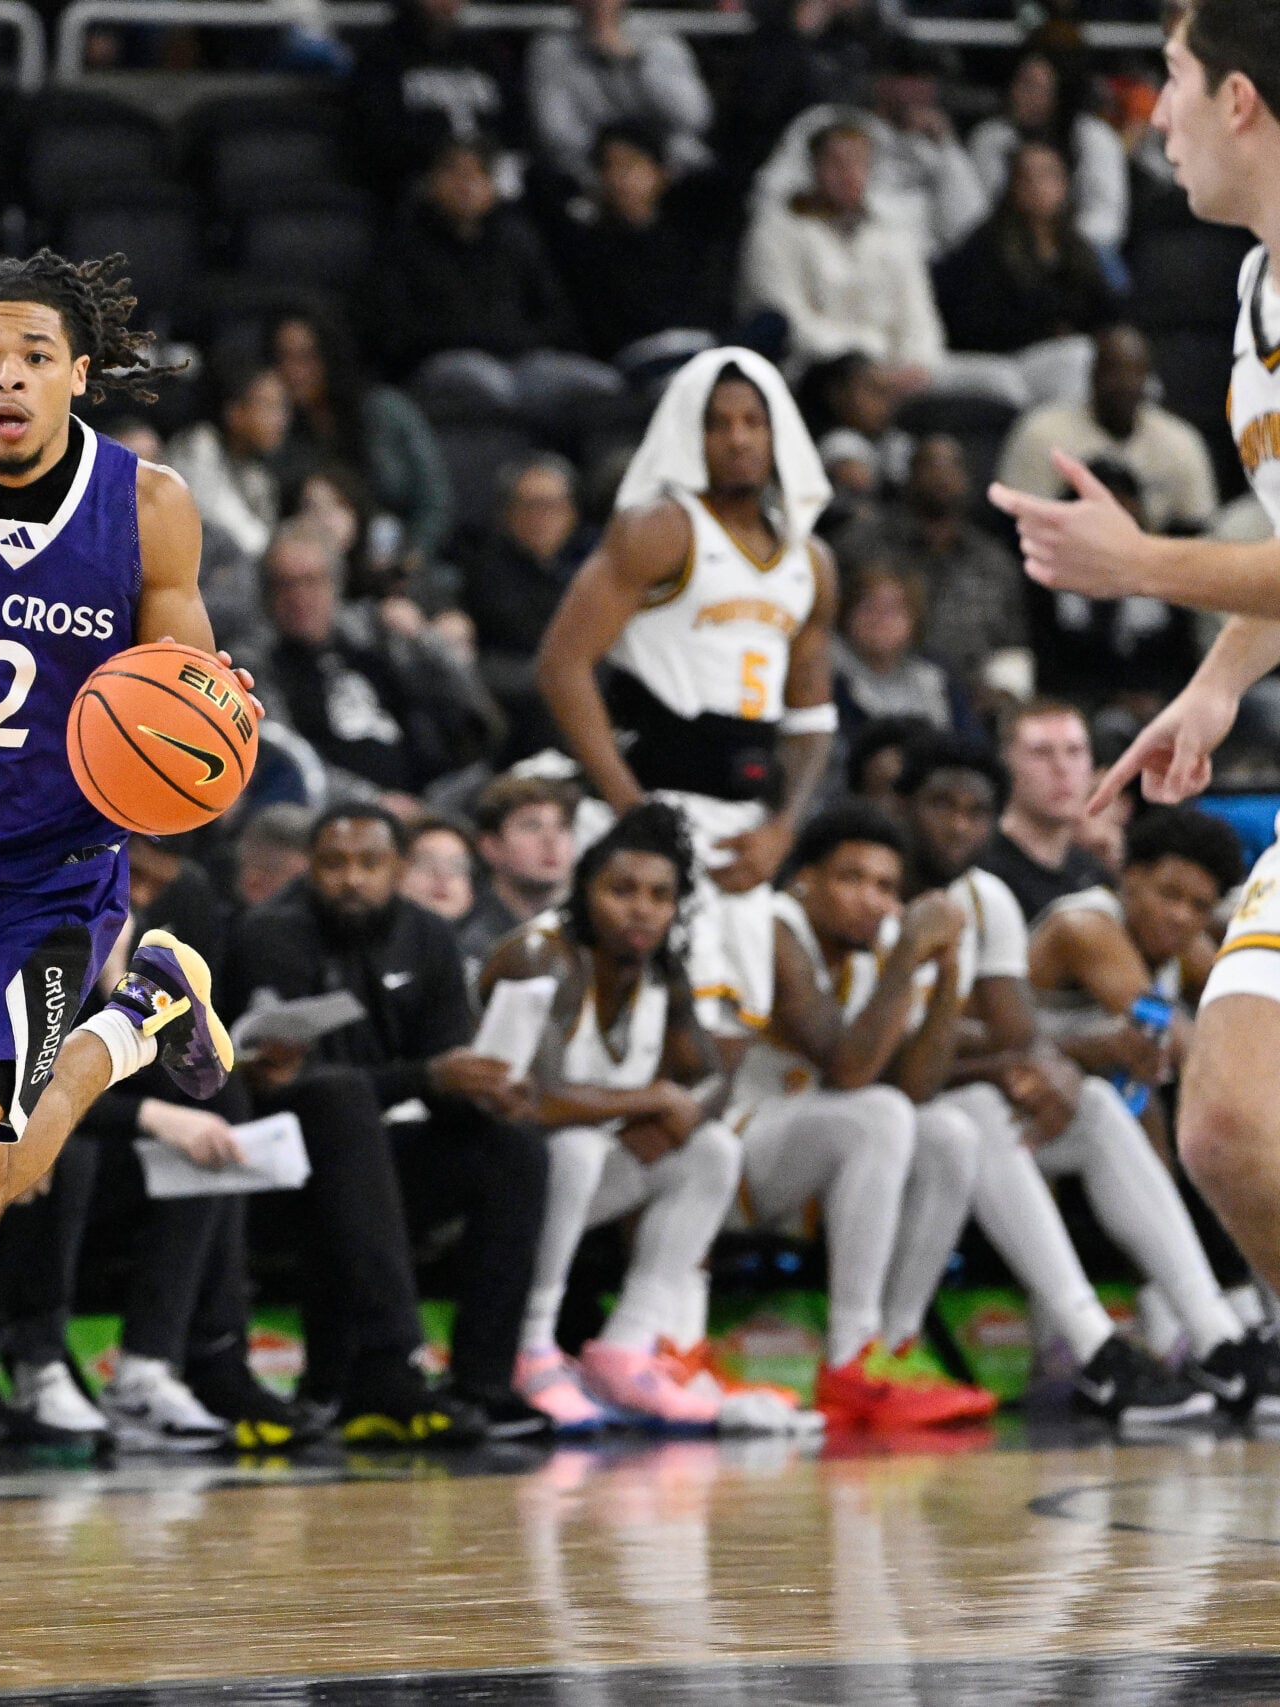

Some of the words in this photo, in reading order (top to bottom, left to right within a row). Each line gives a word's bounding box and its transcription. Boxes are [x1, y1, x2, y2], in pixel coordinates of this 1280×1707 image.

[2, 594, 115, 640] CROSS
[178, 663, 253, 745] ELITE
[740, 650, 769, 721] 5
[30, 966, 66, 1085] CRUSADERS
